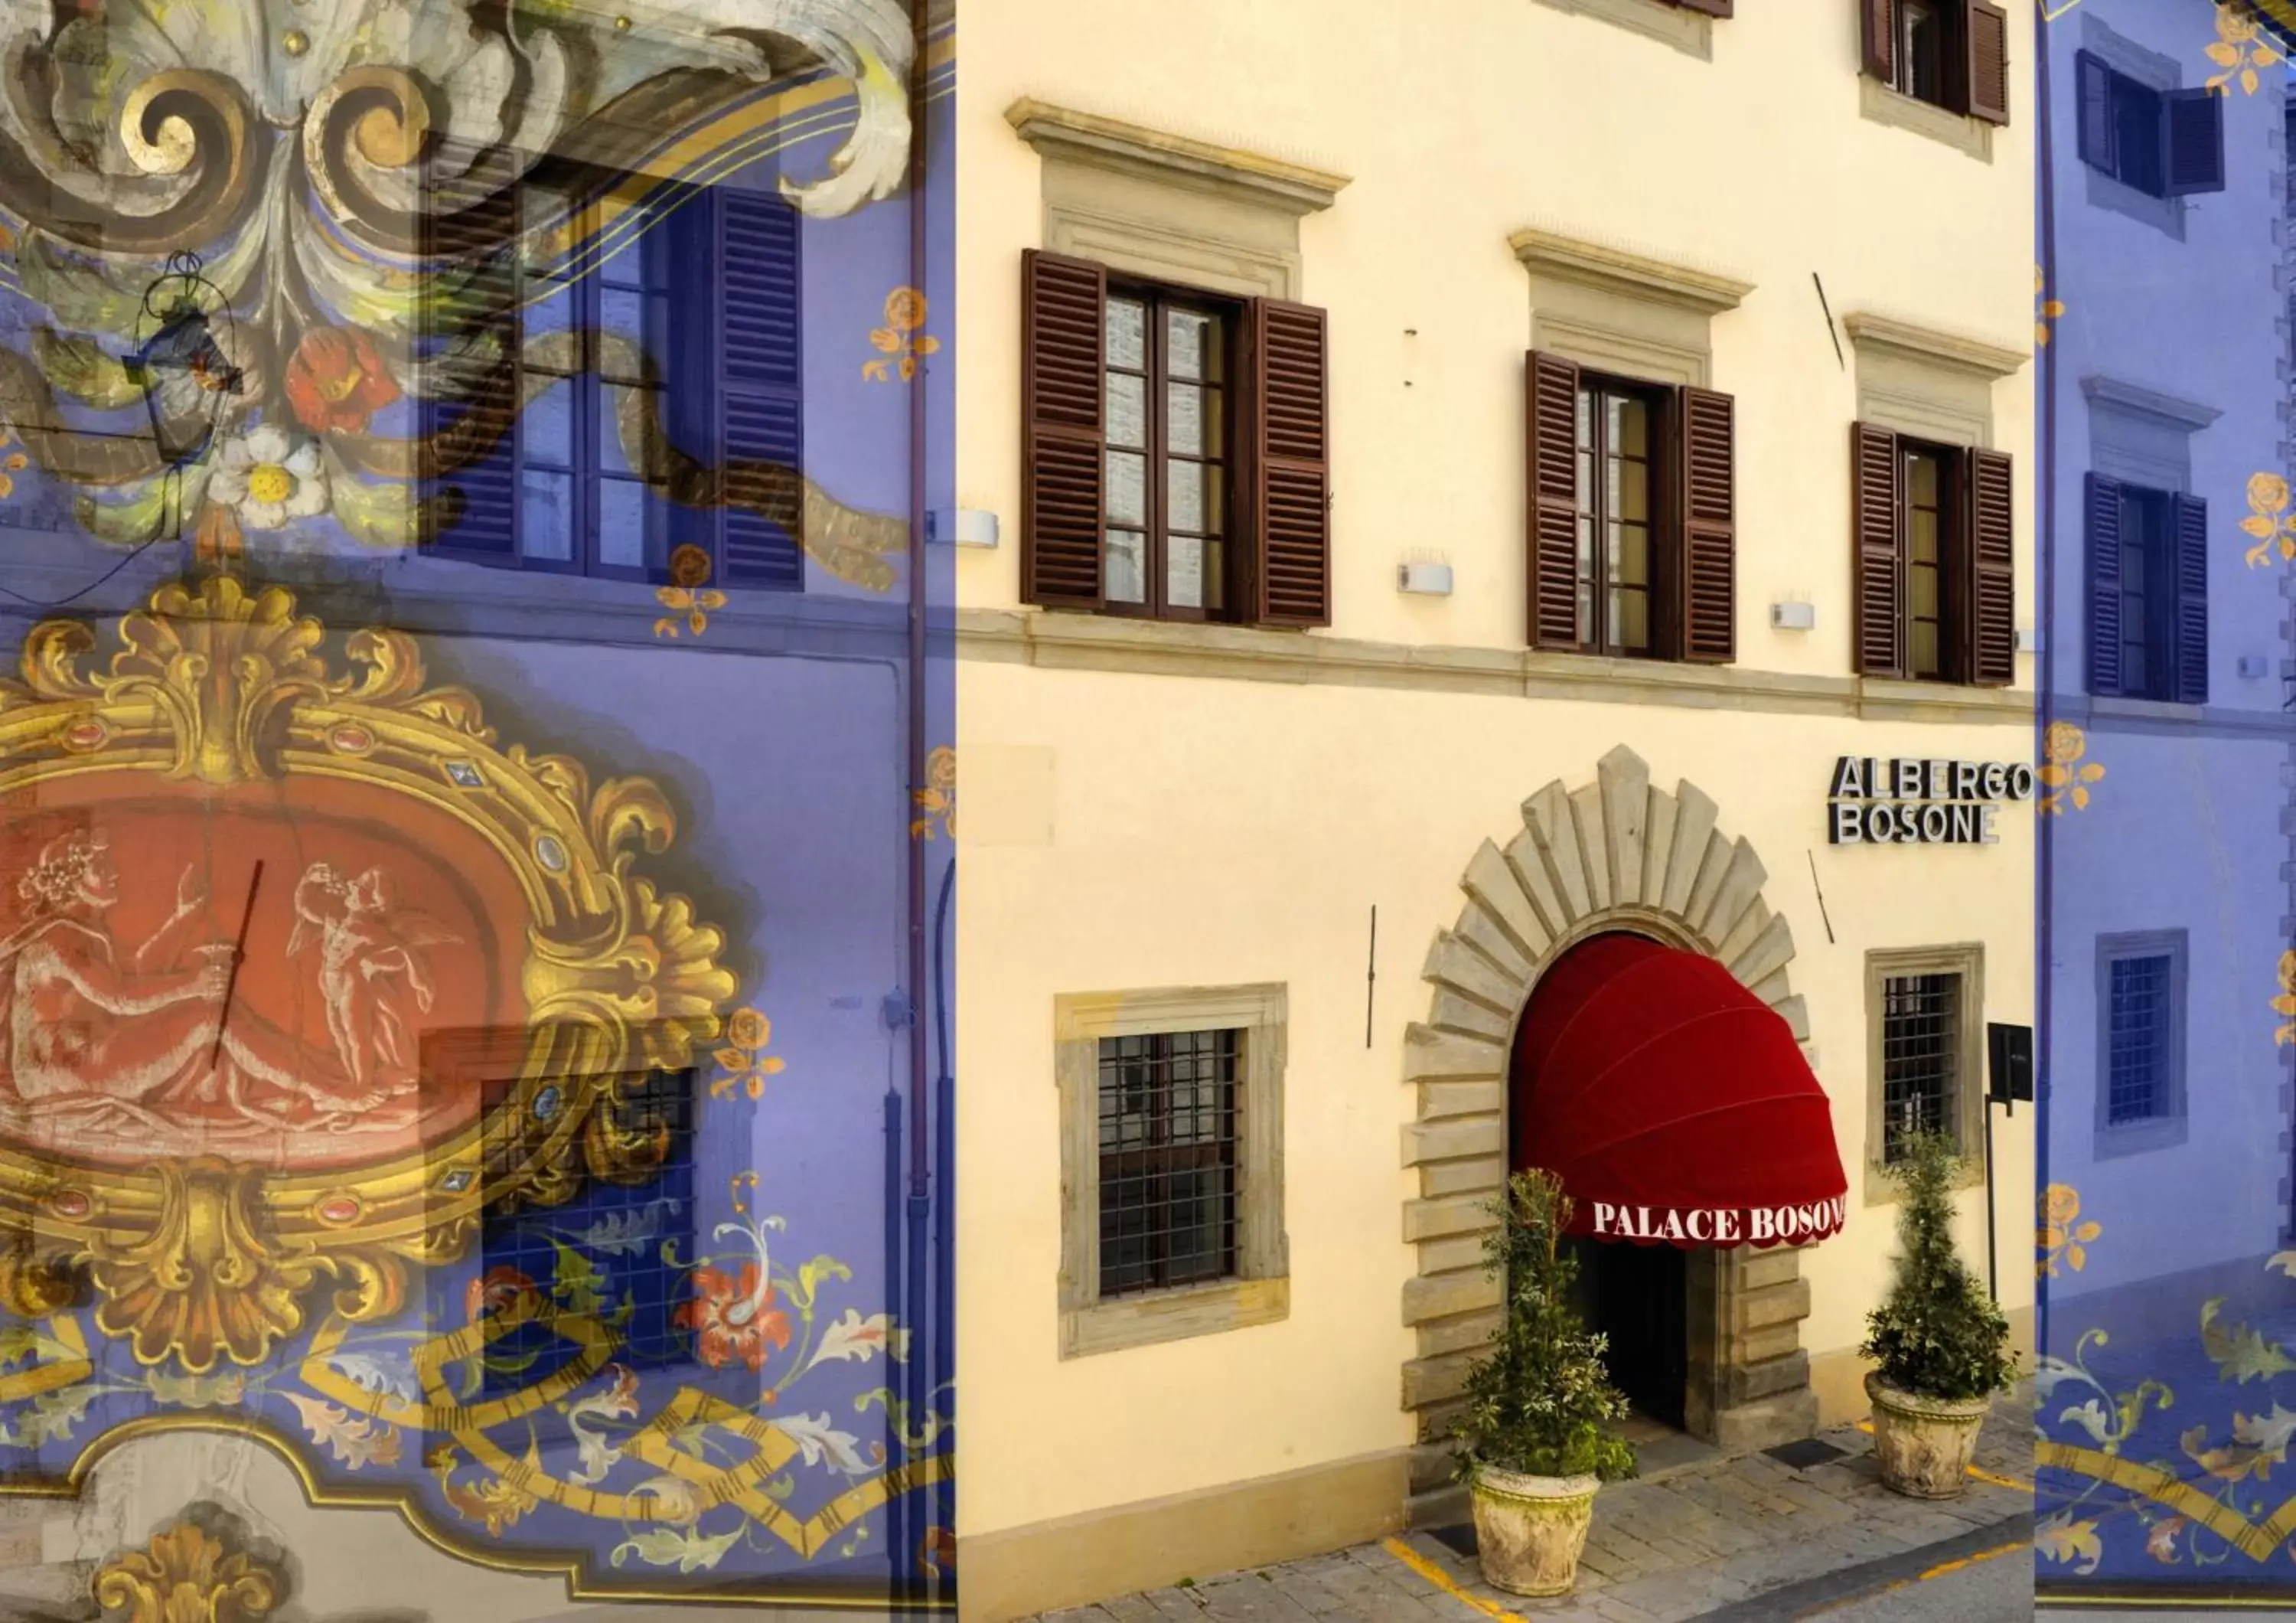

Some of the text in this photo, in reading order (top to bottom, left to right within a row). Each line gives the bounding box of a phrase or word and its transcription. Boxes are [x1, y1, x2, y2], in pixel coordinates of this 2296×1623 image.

[1829, 756, 2034, 800] ALBERGO
[1828, 802, 2000, 844] BOSONE
[1593, 1201, 1740, 1241] PALACE
